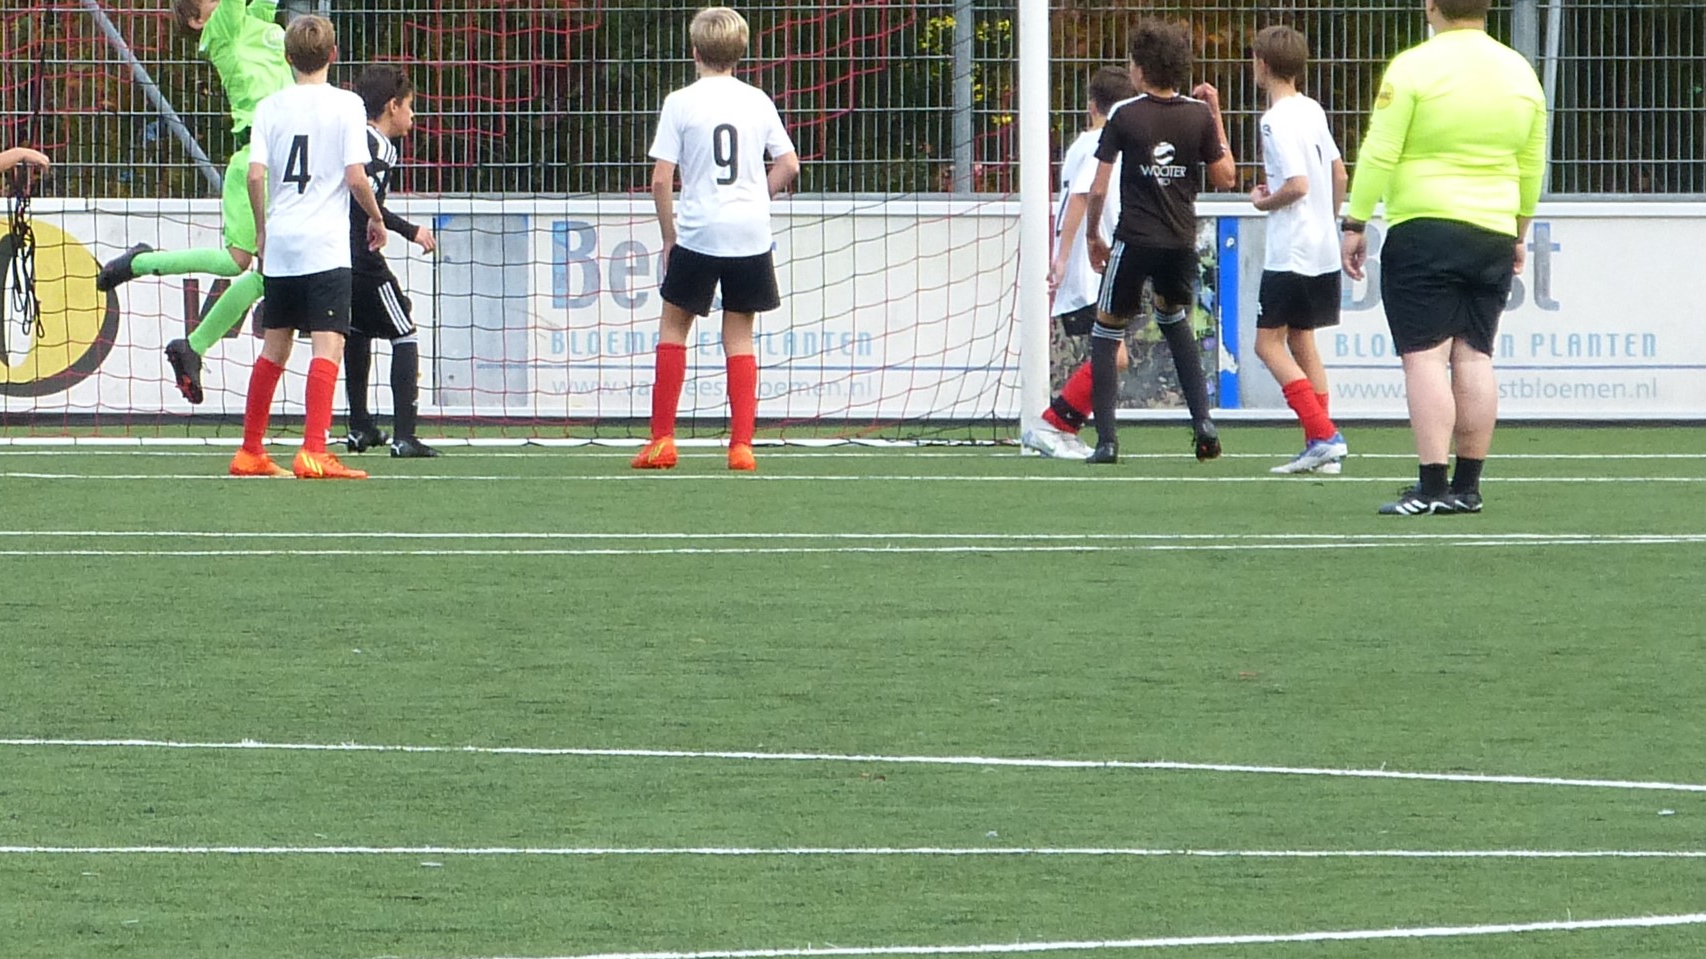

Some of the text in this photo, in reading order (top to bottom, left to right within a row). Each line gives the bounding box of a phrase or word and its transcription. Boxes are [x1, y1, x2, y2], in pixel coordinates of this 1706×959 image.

[282, 135, 312, 194] 4
[713, 123, 739, 186] 9
[1531, 332, 1657, 358] PLANTEN
